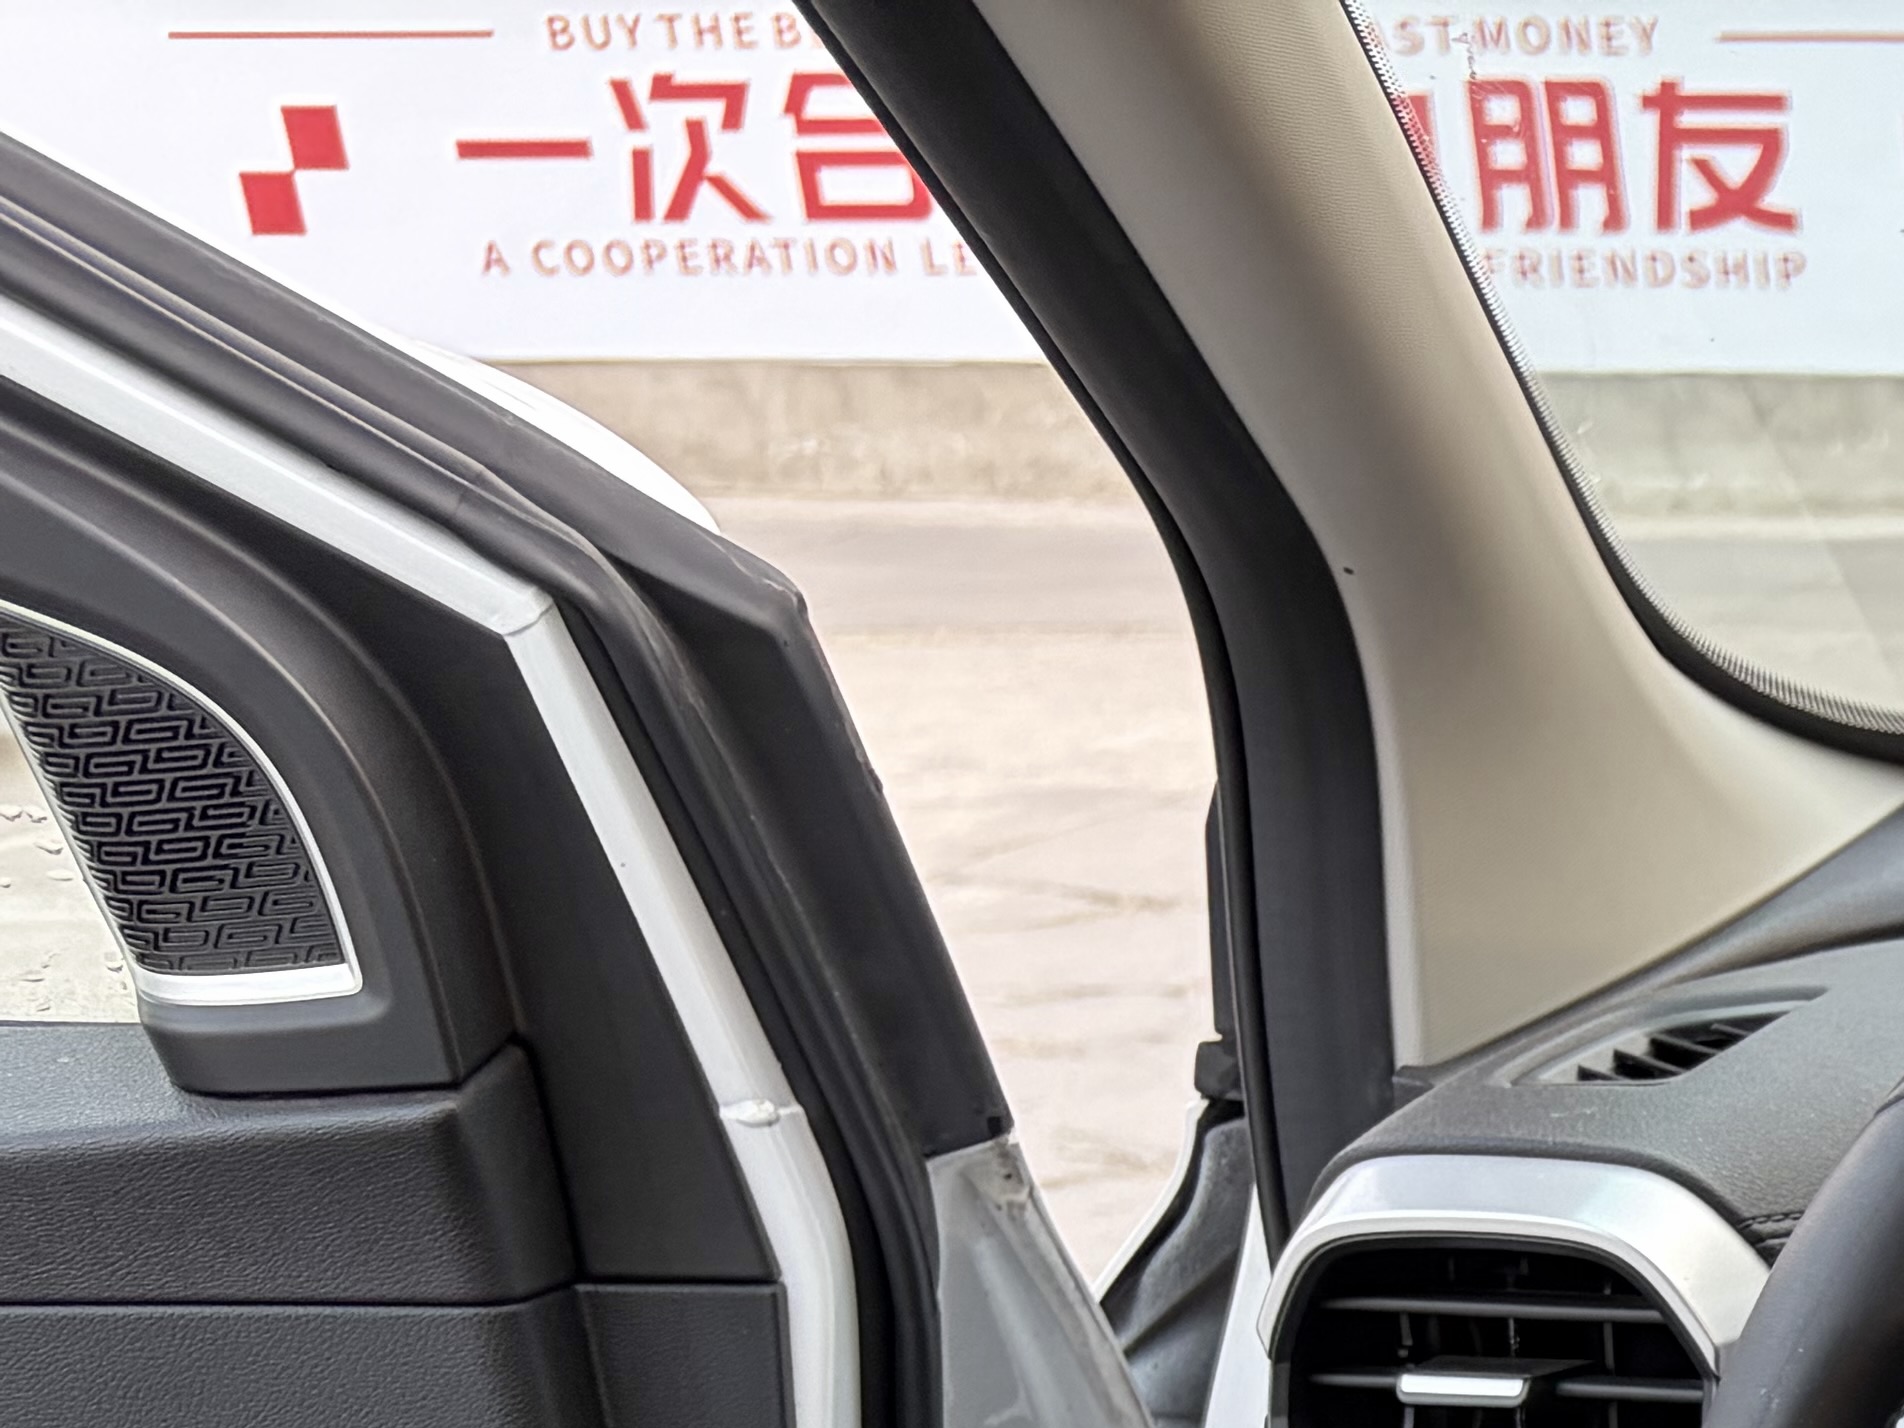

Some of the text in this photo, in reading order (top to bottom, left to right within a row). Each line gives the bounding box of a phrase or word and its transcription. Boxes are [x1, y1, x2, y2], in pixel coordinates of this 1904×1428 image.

[546, 13, 640, 50] BUY
[655, 12, 757, 49] THE
[771, 12, 824, 48] B
[1475, 14, 1659, 55] MONEY
[1397, 76, 1800, 233] 朋友
[483, 240, 510, 275] A
[530, 237, 896, 276] COOPERATION
[1484, 248, 1808, 291] FRIENDSHIP
